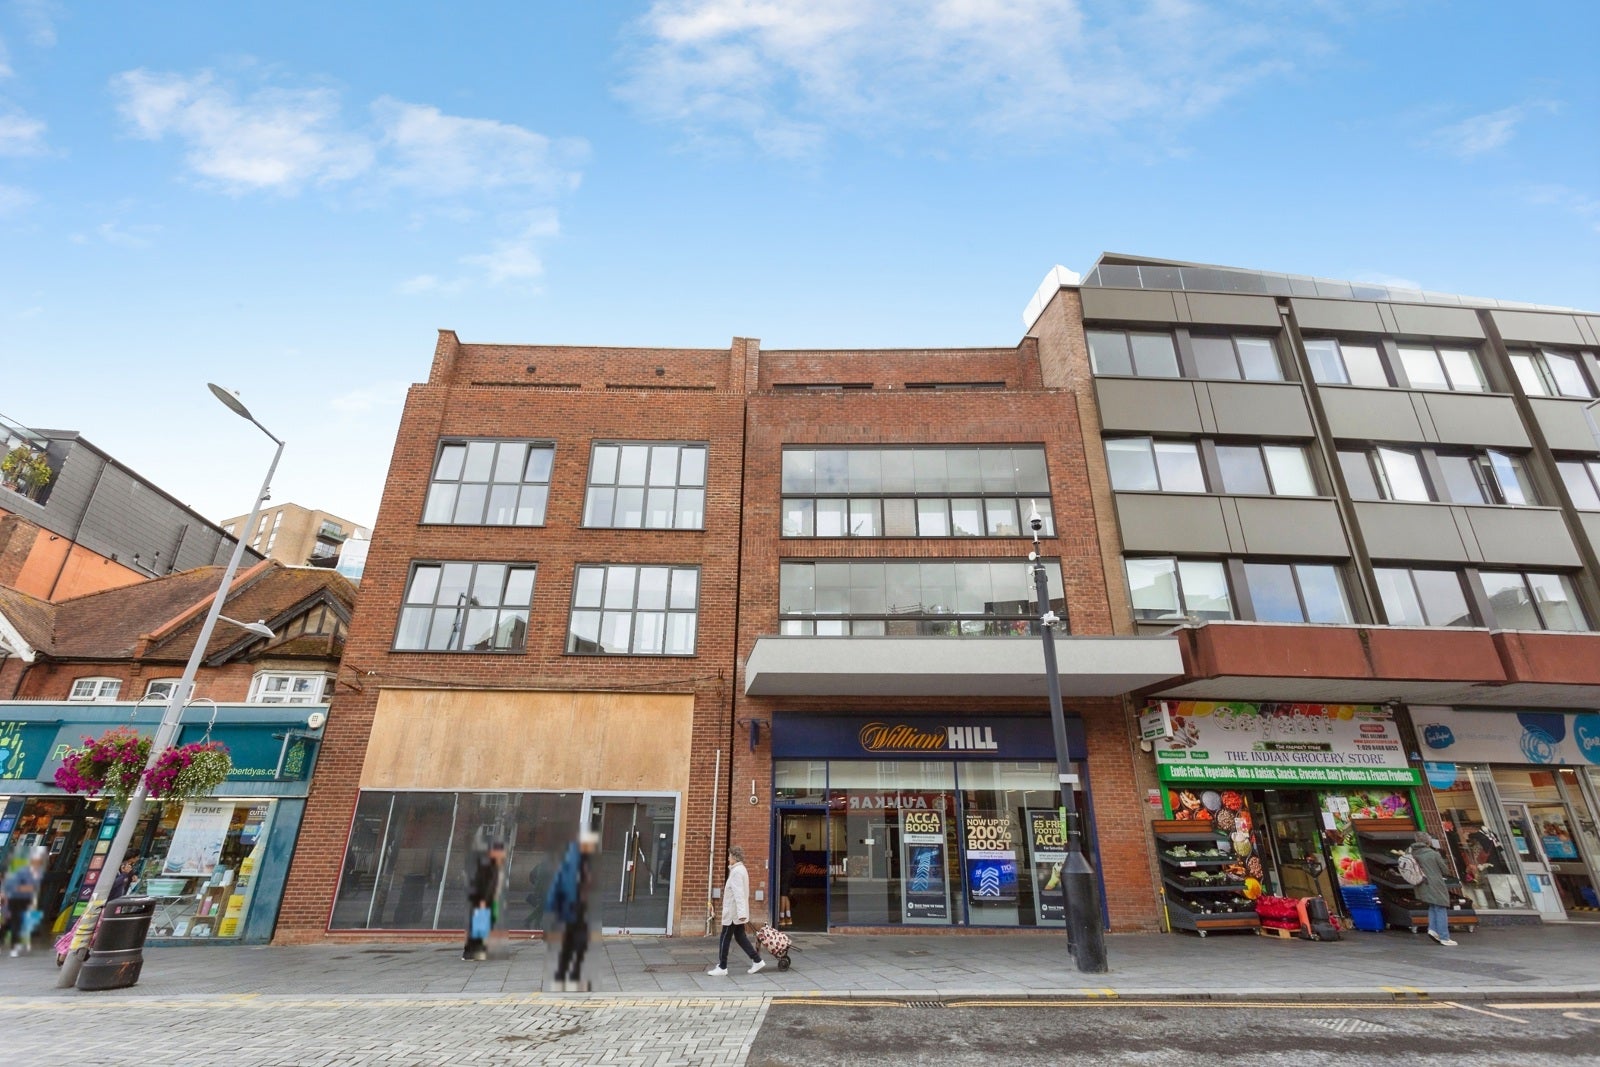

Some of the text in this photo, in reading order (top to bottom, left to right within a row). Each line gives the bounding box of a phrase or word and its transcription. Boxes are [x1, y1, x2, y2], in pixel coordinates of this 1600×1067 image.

[859, 722, 998, 751] William HILL
[1224, 751, 1386, 764] THE INDIAN GROCERY STORE
[1170, 766, 1188, 777] Exotic
[1237, 767, 1250, 778] Nuts
[1326, 769, 1342, 781] Dairy
[1340, 769, 1367, 780] Products
[1370, 770, 1389, 780] Frozen
[1388, 770, 1414, 781] Products
[905, 812, 940, 824] ACCA
[905, 823, 941, 833] BOOST
[1033, 820, 1062, 829] £5 FRE
[967, 825, 1012, 840] 200%
[968, 839, 1012, 850] BOOST
